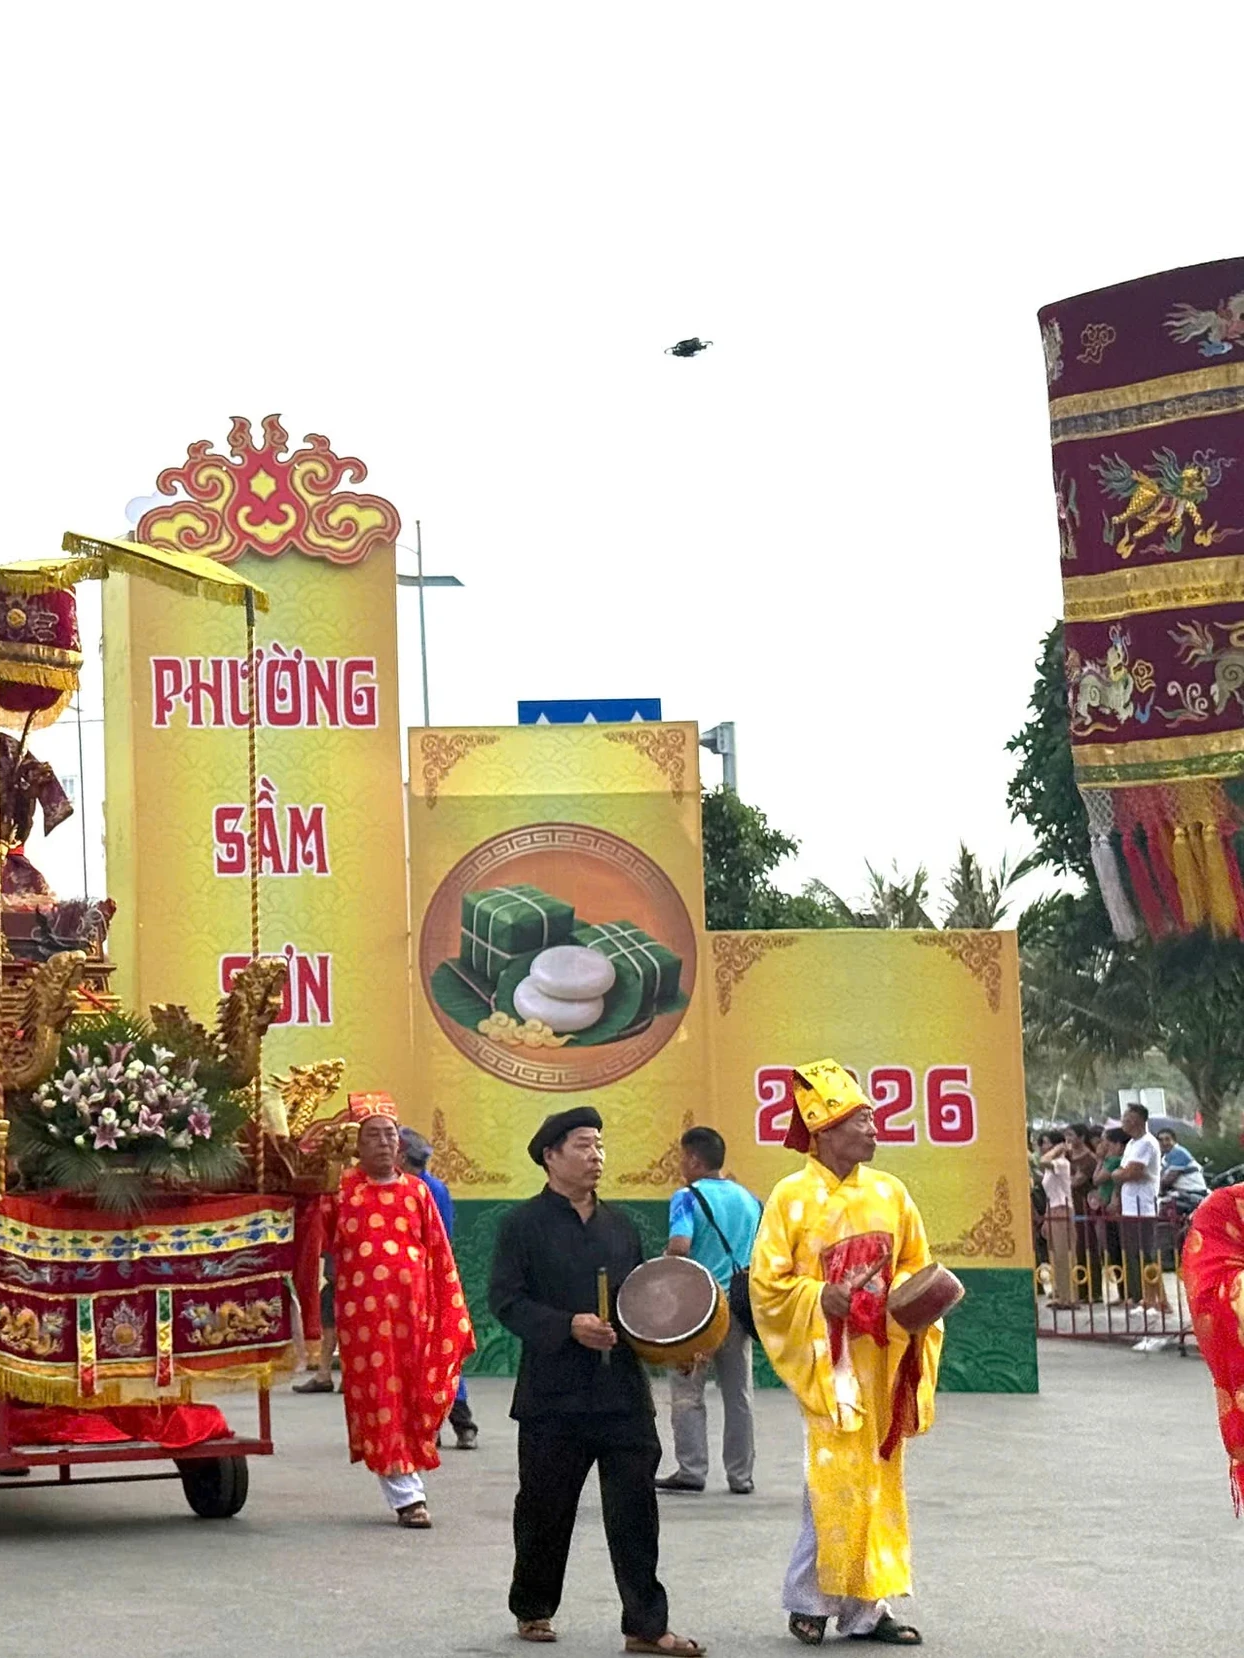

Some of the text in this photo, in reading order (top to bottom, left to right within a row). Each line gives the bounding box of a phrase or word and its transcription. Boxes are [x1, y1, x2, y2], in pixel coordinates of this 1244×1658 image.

[152, 643, 377, 727] PHƯỜNG
[215, 777, 329, 875] SẦM
[758, 1068, 974, 1142] 226
